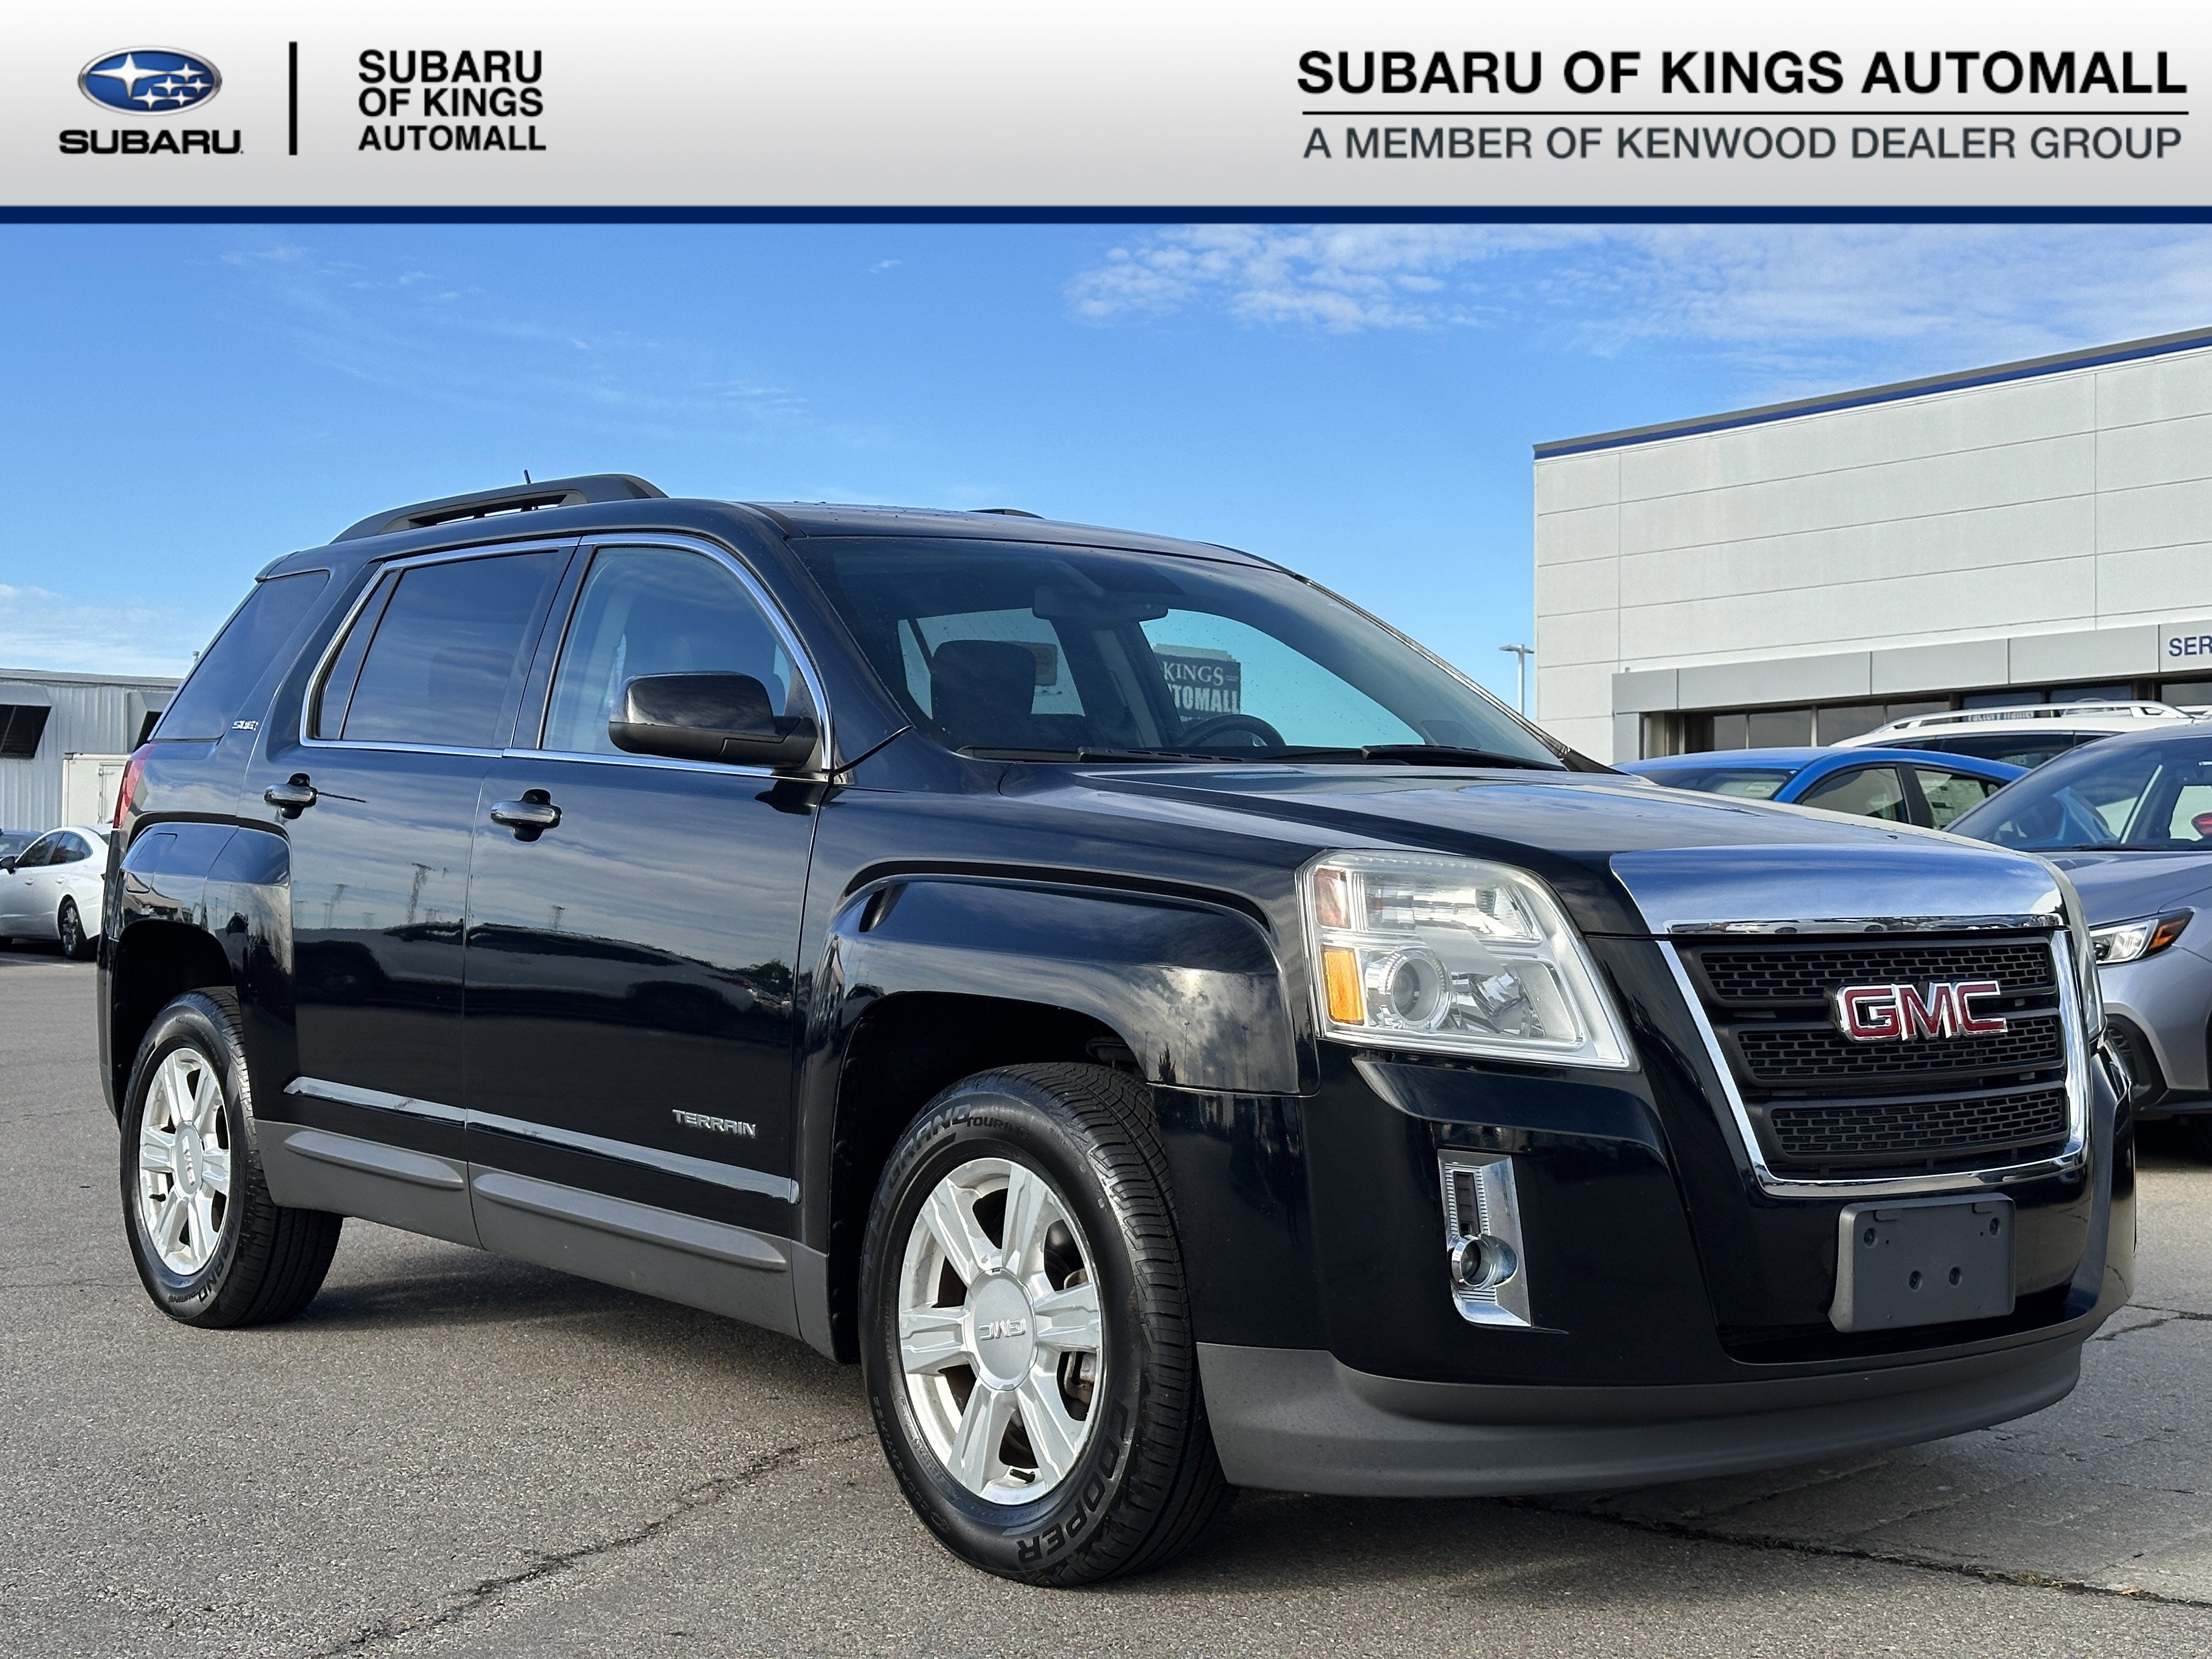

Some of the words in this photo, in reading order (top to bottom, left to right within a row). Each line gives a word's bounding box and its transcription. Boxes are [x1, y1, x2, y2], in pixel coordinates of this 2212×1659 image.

[2168, 635, 2212, 657] SER
[1163, 661, 1223, 686] KINGS
[1167, 684, 1240, 714] TOMALL
[1837, 980, 2008, 1041] GMC
[672, 1108, 756, 1138] TERRAIN
[888, 1103, 972, 1189] GRAND
[978, 1318, 1026, 1341] GMC
[1016, 1396, 1128, 1563] COOPER
